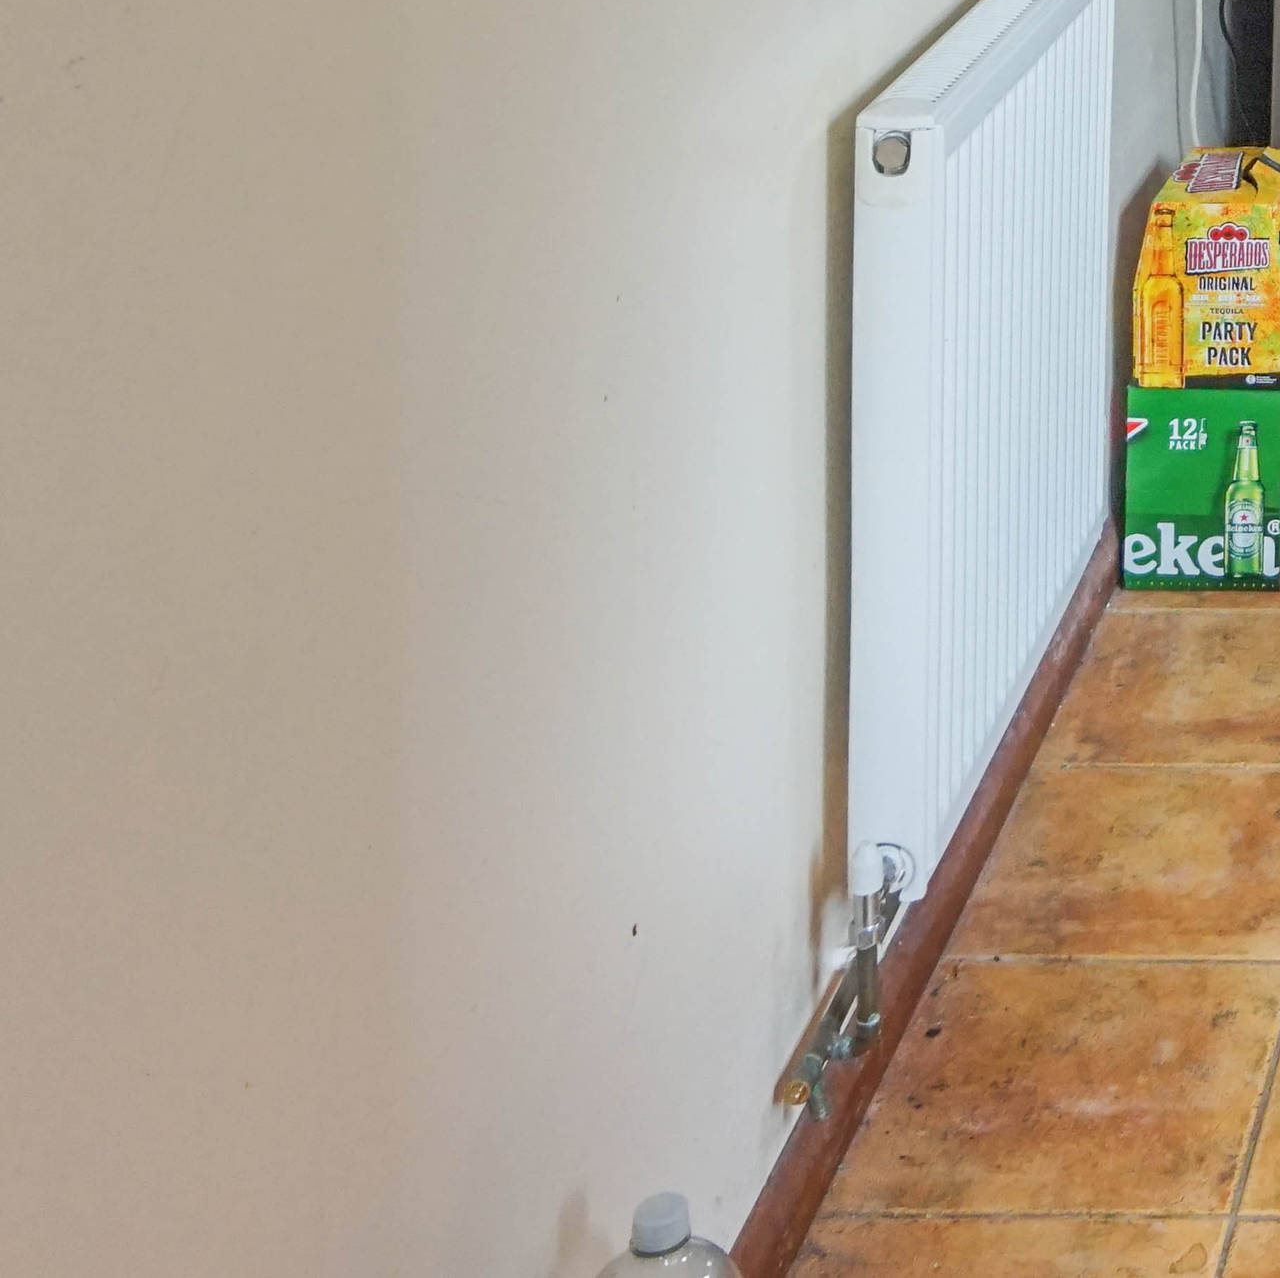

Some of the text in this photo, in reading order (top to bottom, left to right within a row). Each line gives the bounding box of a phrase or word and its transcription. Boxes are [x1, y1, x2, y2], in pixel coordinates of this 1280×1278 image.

[1188, 240, 1268, 271] DESPERADOS
[1199, 276, 1256, 291] ORIGINAL
[1209, 307, 1245, 315] TEQUILA
[1201, 321, 1258, 341] PARTY
[1207, 346, 1252, 366] PACK
[1169, 417, 1198, 440] 12
[1169, 440, 1197, 450] PACK
